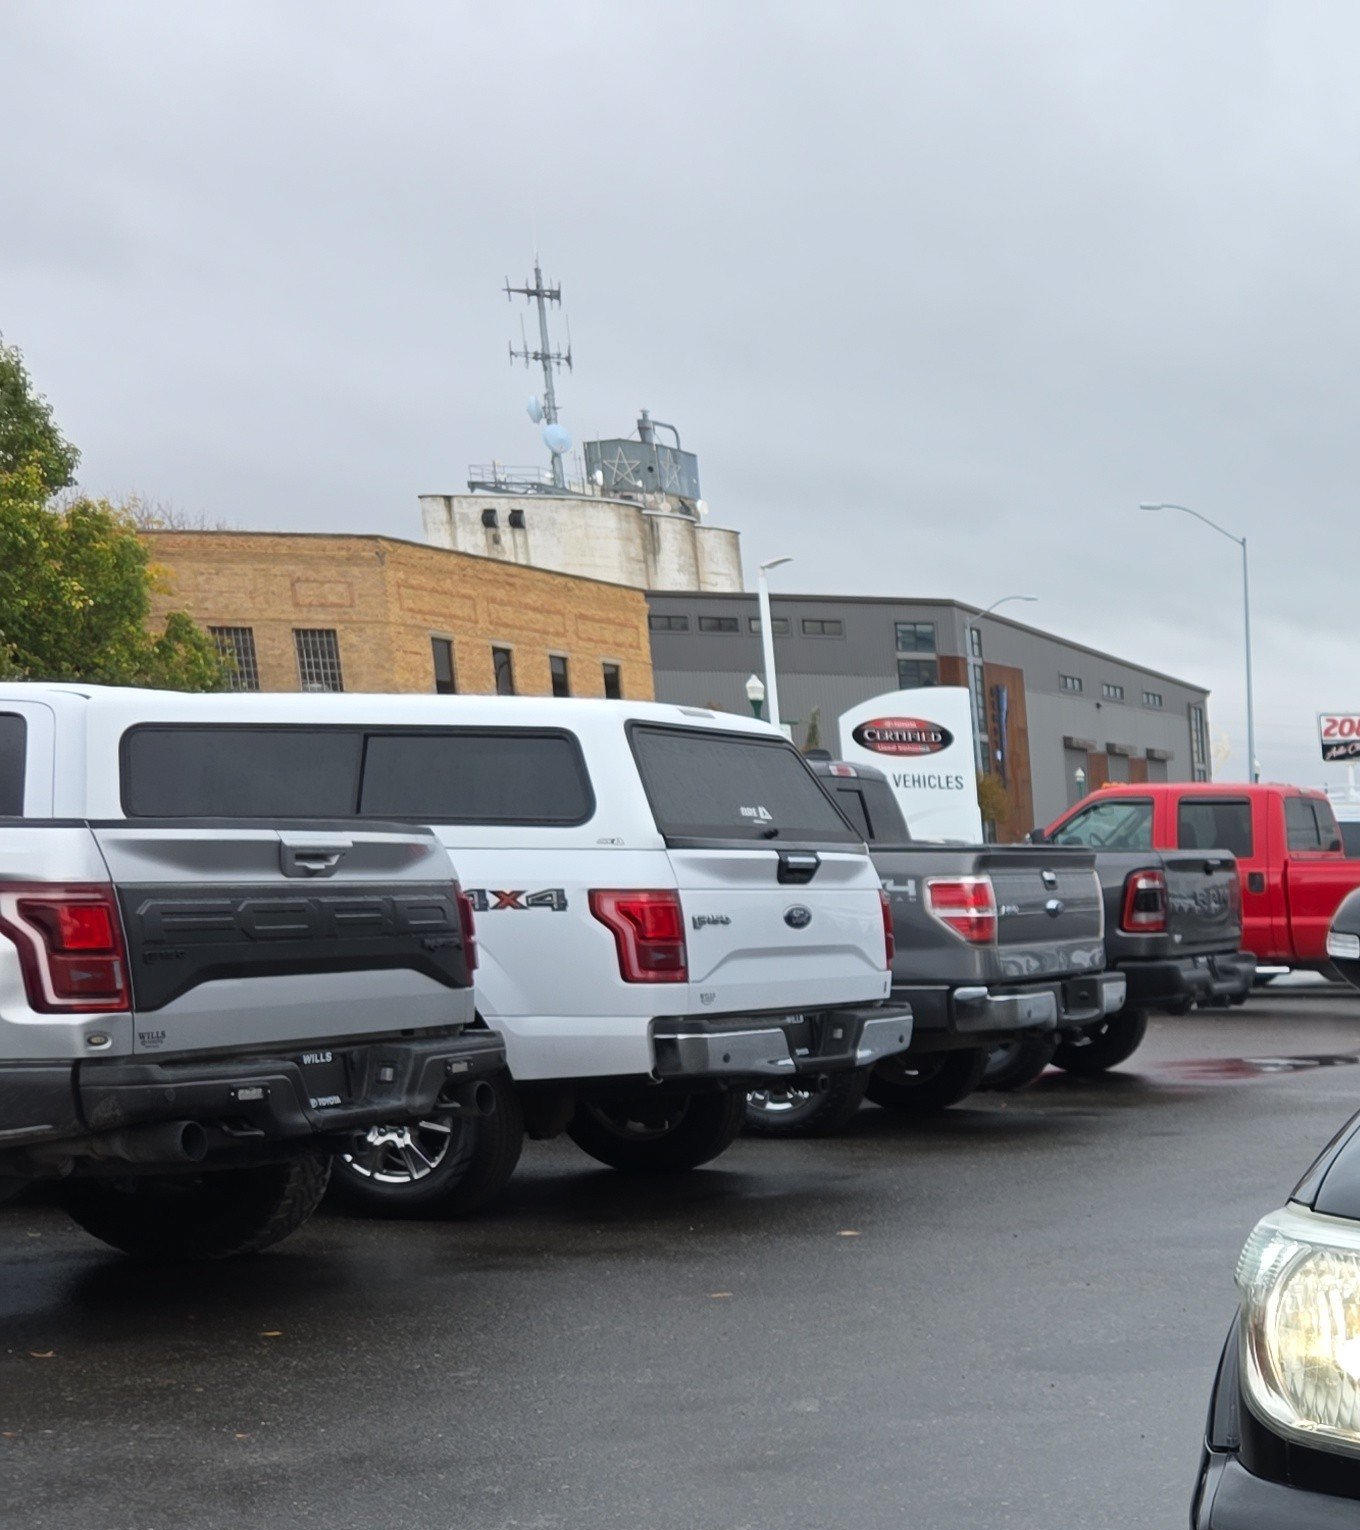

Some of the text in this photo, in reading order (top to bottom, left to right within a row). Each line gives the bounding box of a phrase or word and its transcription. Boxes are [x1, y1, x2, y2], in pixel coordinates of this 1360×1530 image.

[863, 729, 942, 742] CERTIFIED
[892, 773, 964, 790] VEHICLES
[138, 1030, 166, 1040] WILLS
[302, 1051, 333, 1064] WILLS
